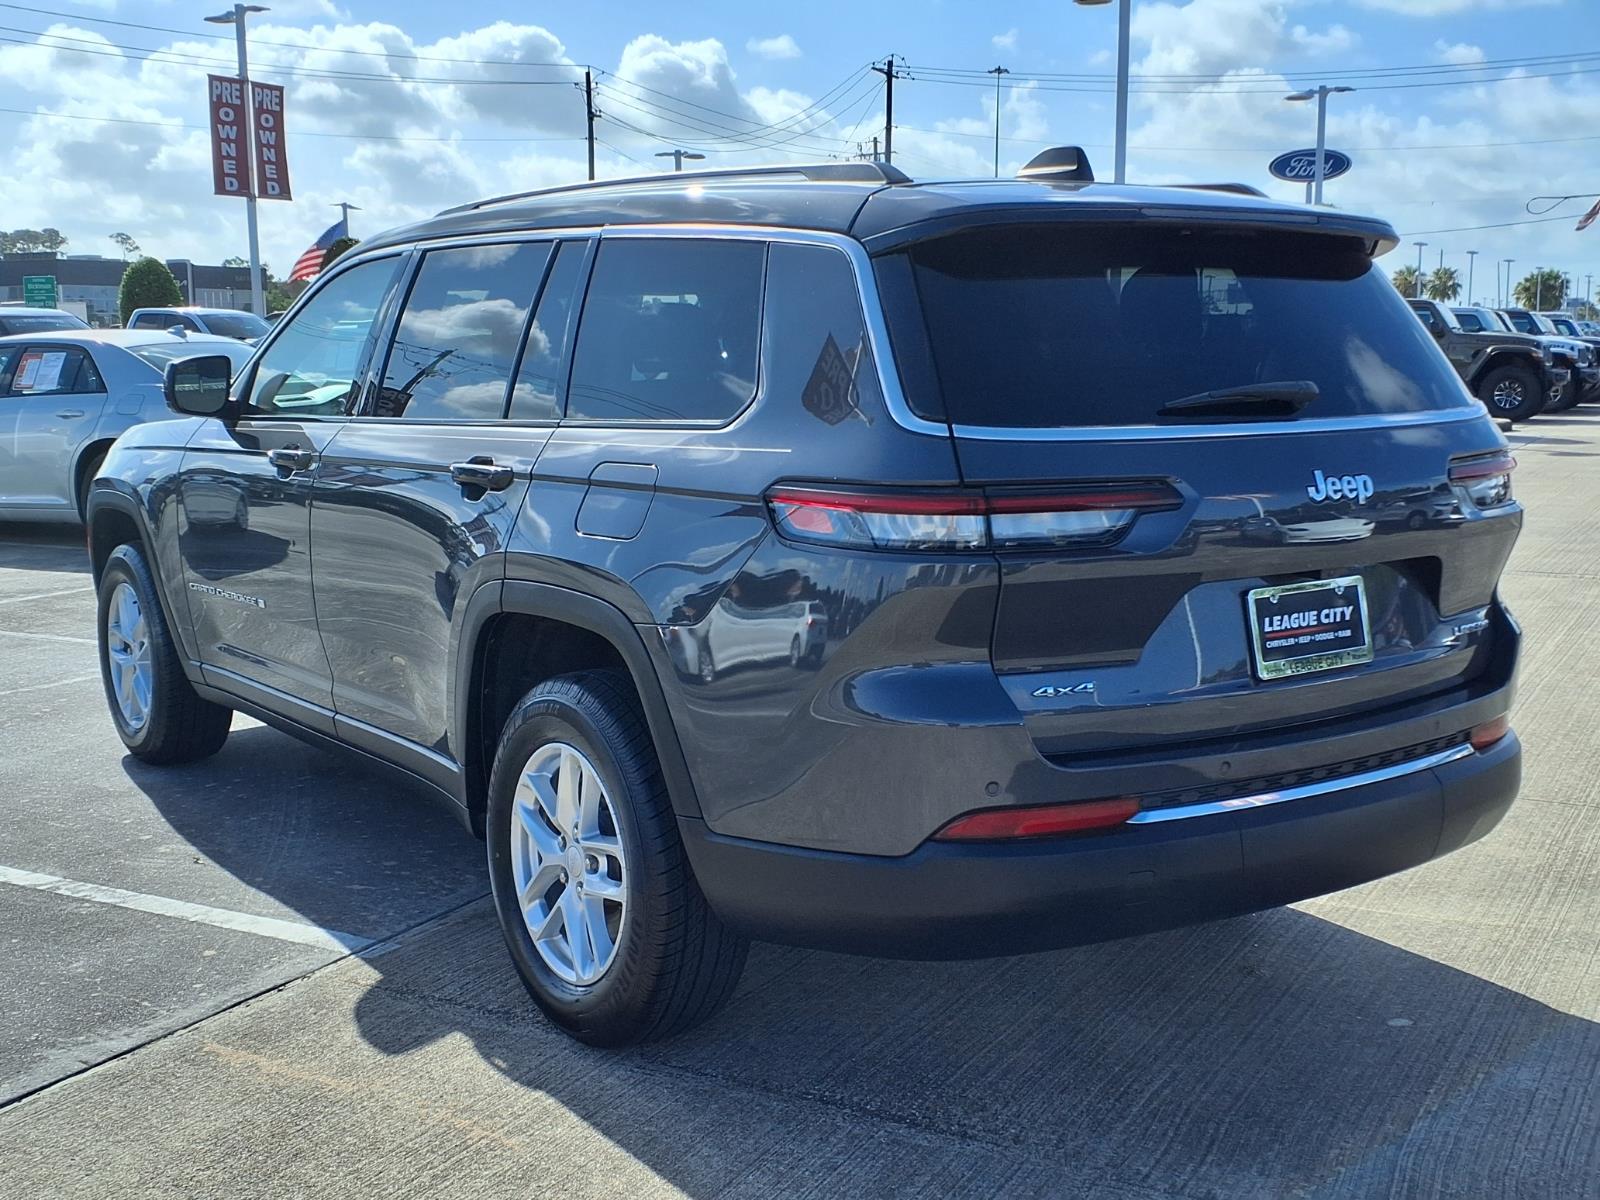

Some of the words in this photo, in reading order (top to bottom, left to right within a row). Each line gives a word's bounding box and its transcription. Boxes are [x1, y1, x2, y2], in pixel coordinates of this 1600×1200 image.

[212, 80, 241, 105] PRE
[254, 87, 281, 112] PRE
[217, 107, 239, 192] OWNED
[259, 113, 281, 195] OWNED
[1307, 469, 1375, 505] Jeep
[1264, 610, 1318, 632] LEAGUE
[1320, 605, 1354, 624] CITY
[1266, 638, 1295, 649] CHRYSLER
[1298, 635, 1311, 644] JEEP
[1315, 632, 1335, 641] DODGE
[1032, 682, 1094, 697] 4x4
